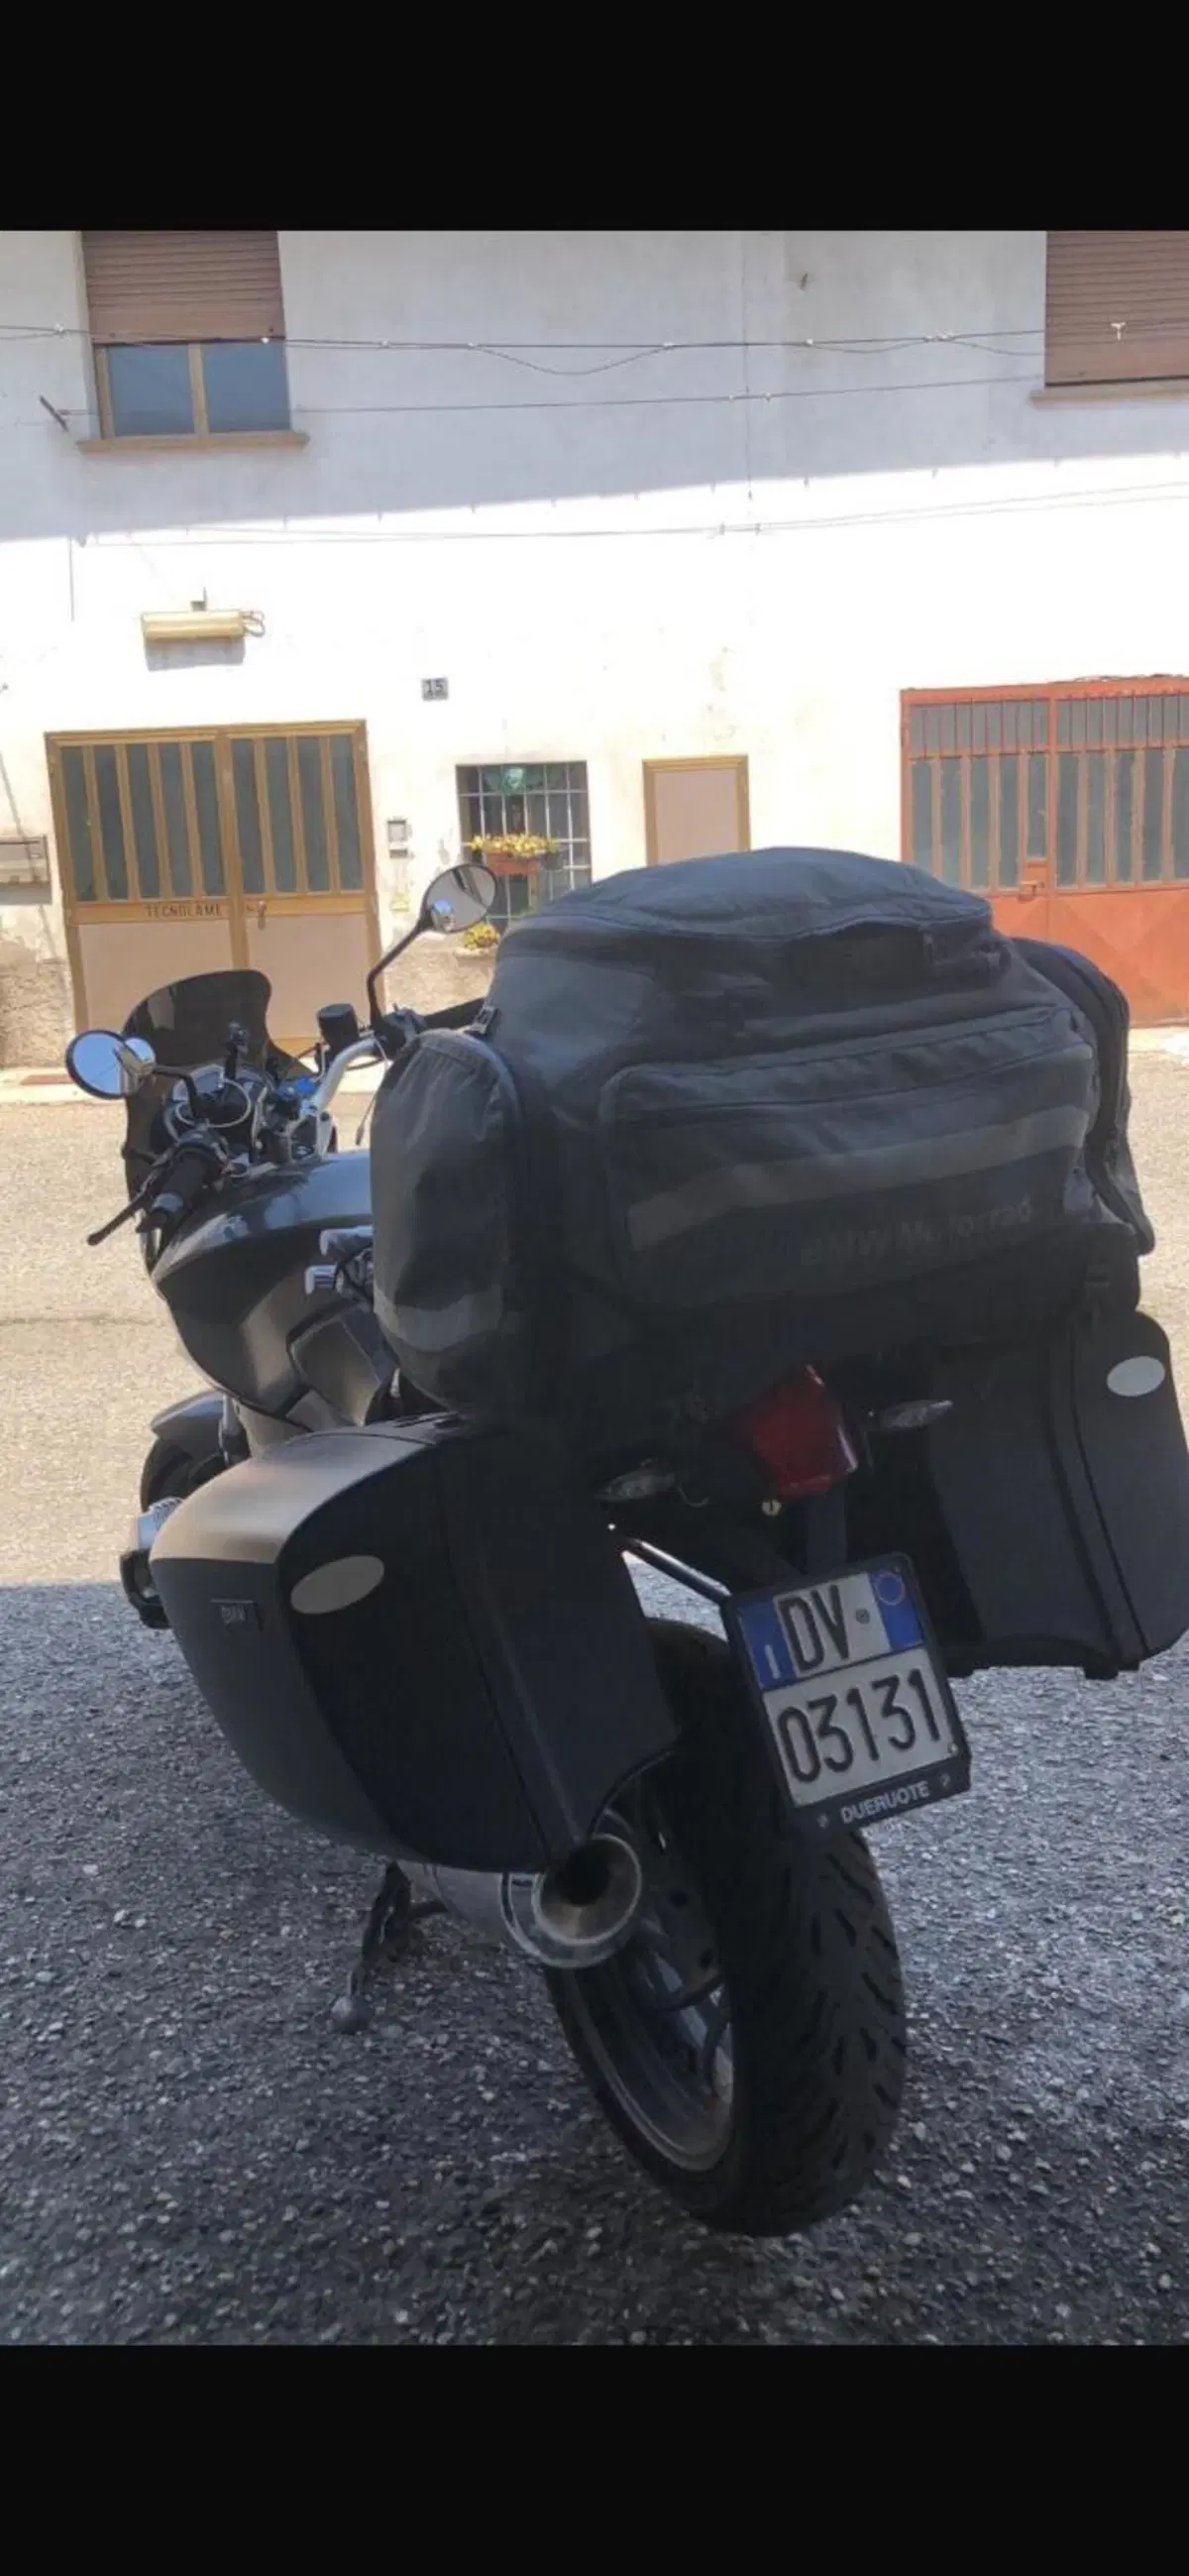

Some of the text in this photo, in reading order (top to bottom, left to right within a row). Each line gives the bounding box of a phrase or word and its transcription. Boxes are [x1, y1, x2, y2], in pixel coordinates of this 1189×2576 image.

[777, 1585, 849, 1673] DV
[778, 1669, 940, 1782] 03131
[841, 1781, 930, 1823] DUERUOTE
